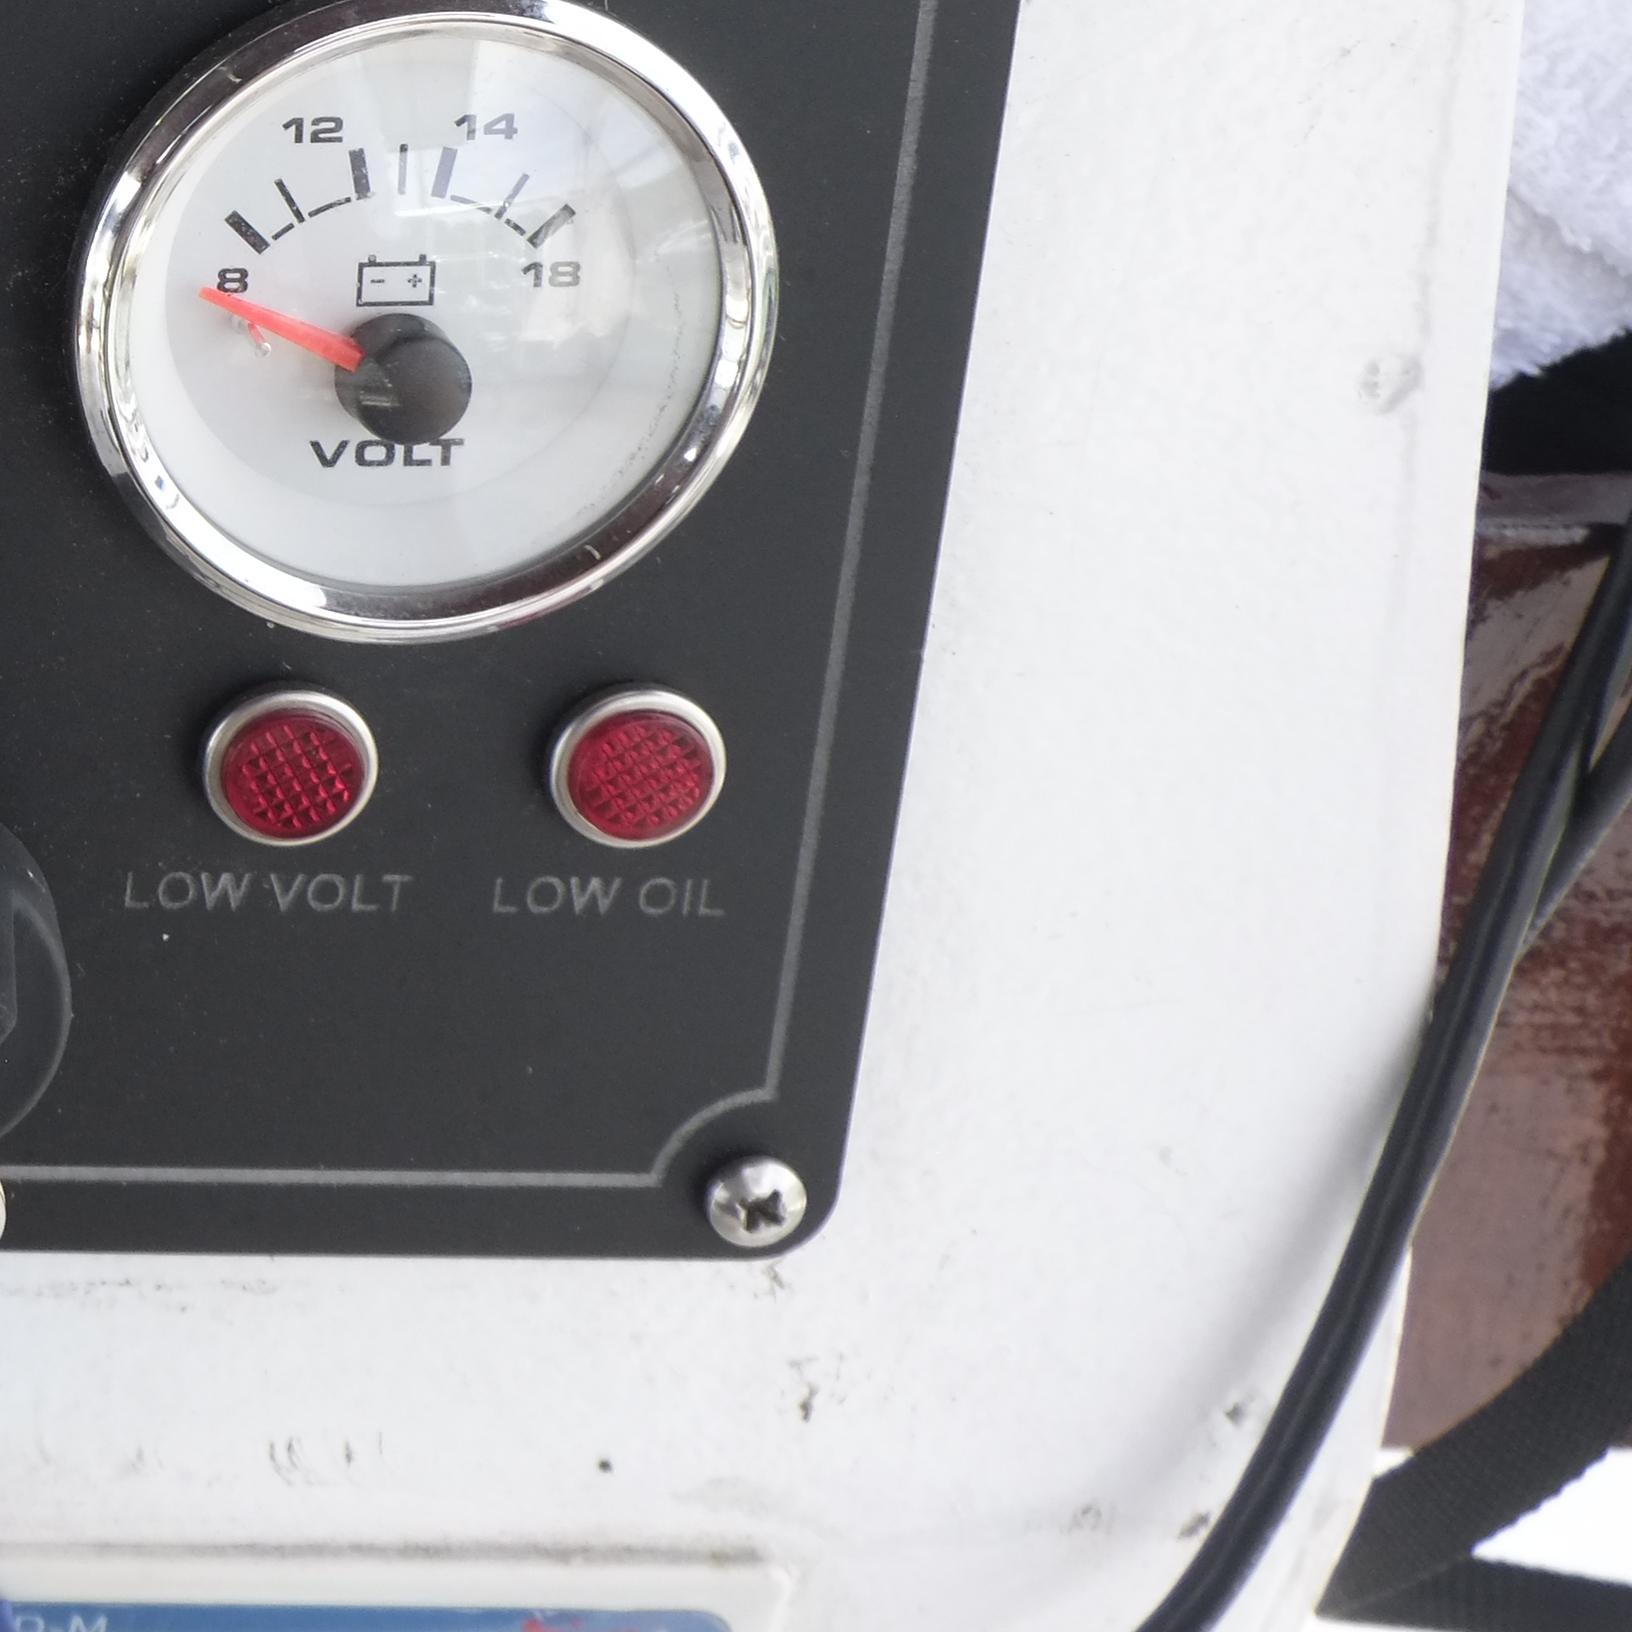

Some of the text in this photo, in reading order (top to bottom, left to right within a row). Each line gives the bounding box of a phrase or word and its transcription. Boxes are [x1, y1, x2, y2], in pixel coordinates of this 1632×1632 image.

[283, 116, 343, 142] 12
[454, 112, 517, 139] 14
[217, 268, 248, 293] 8
[523, 261, 580, 287] 18
[309, 439, 464, 467] VOLT
[124, 871, 413, 913] LOW VOLT
[492, 875, 726, 917] LOW OIL
